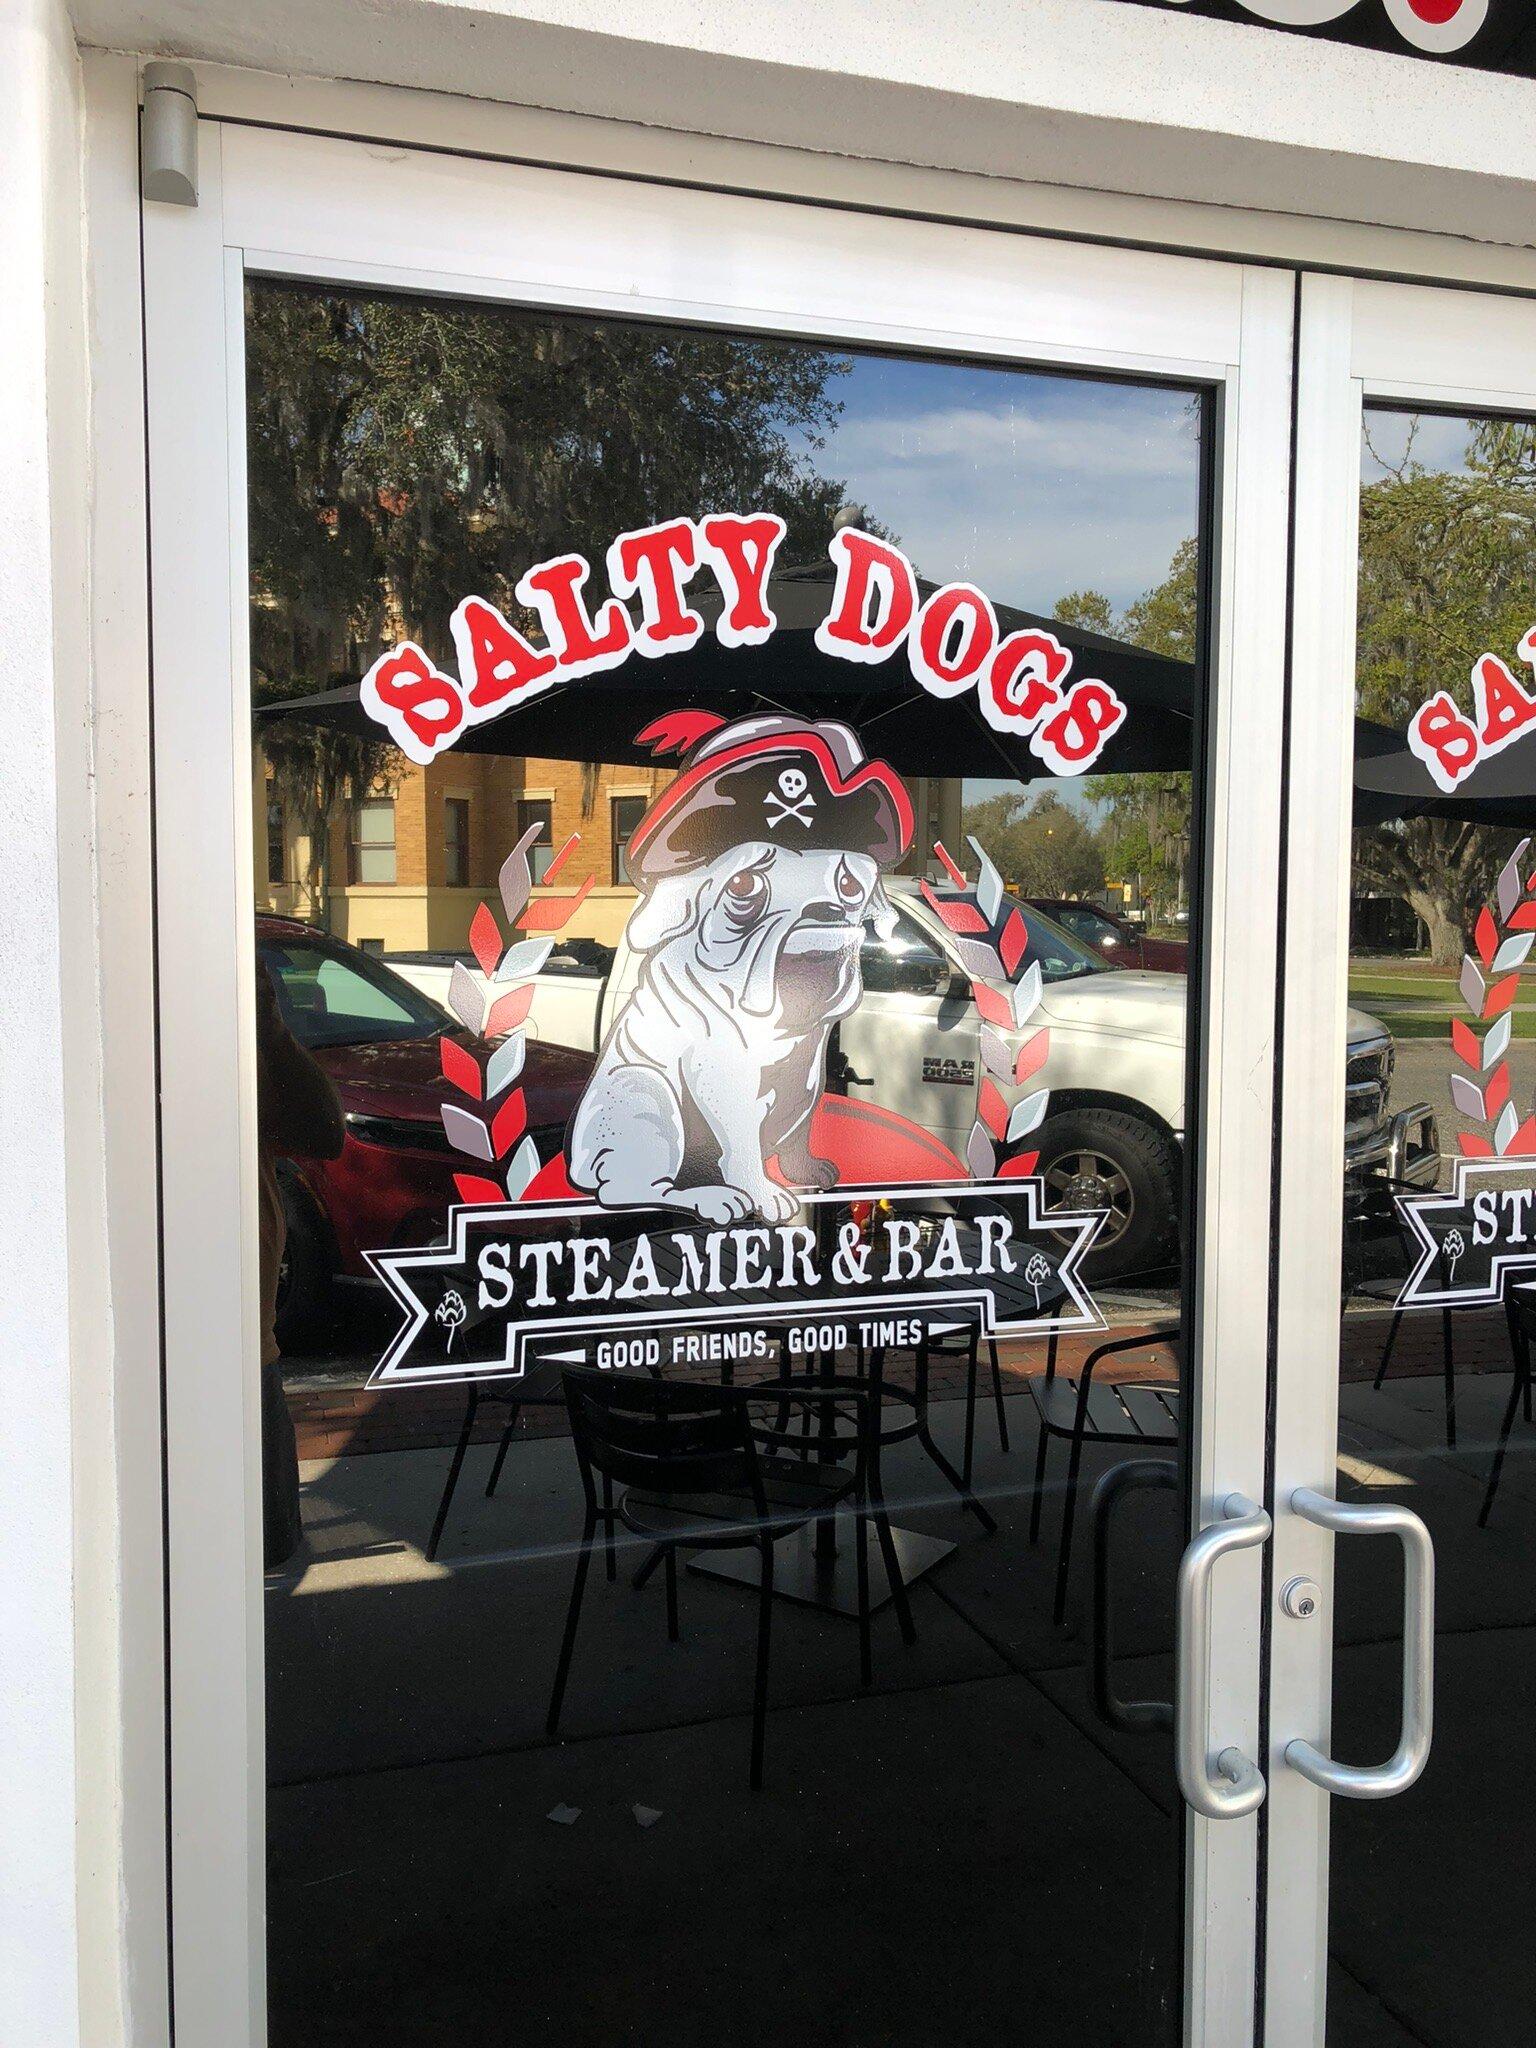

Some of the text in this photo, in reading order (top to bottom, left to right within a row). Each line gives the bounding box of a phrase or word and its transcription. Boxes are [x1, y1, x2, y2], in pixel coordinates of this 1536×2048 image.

[361, 512, 1128, 776] SALTY DOGS
[1407, 626, 1536, 793] SA
[477, 1215, 1018, 1310] STEAMER & BAR
[597, 1318, 922, 1369] GOOD FRIENDS, GOOD TIMES
